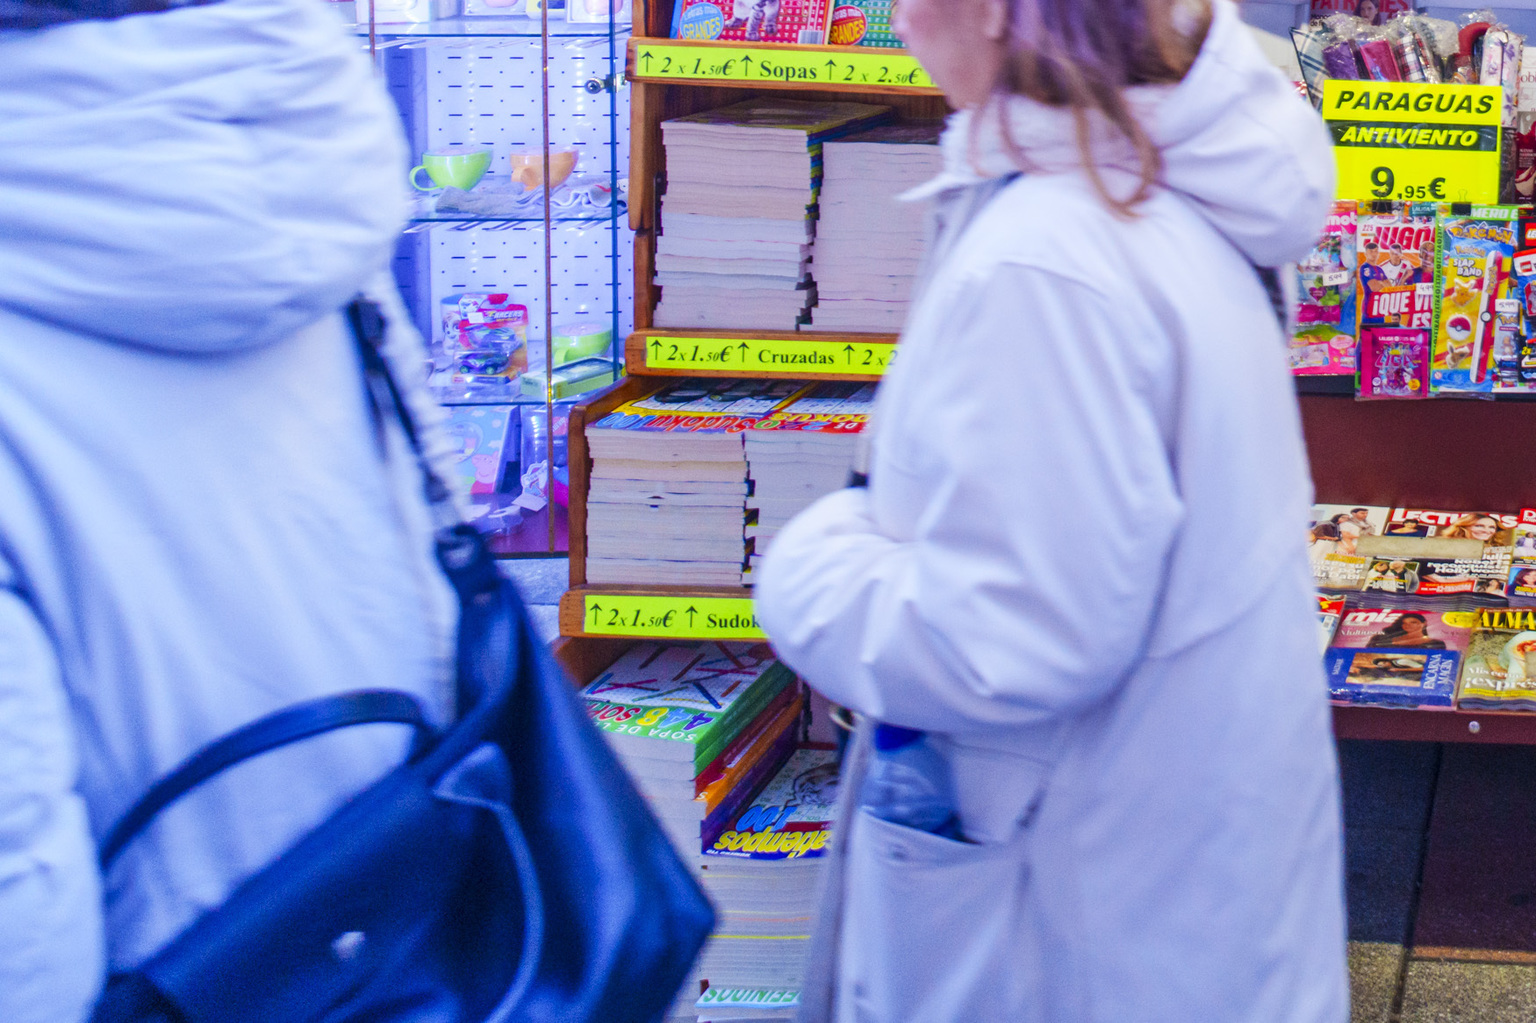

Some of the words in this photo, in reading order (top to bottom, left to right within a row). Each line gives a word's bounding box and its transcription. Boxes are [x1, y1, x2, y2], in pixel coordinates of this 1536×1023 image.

[683, 17, 722, 39] GRANDES
[661, 56, 671, 72] 2
[677, 63, 685, 74] x
[692, 56, 736, 76] 1.50€
[760, 59, 818, 82] Sopas
[843, 64, 855, 79] 2
[859, 71, 869, 82] x
[876, 66, 921, 84] 2.50€
[1335, 90, 1494, 114] PARAGUAS
[1340, 125, 1478, 147] ANTIVIENTO
[1453, 257, 1475, 267] SLAP
[1457, 266, 1483, 277] BAND
[667, 344, 677, 361] 2
[678, 351, 686, 362] x
[689, 345, 733, 362] 1.50€
[758, 349, 835, 364] Cruzadas
[861, 350, 874, 365] 2
[876, 356, 885, 366] x
[596, 412, 653, 430] 100
[646, 414, 755, 434] Sudoku
[606, 608, 618, 626] 2
[618, 616, 626, 627] x
[631, 609, 677, 627] 1.50€
[706, 613, 761, 629] Sudok
[1343, 609, 1403, 625] mia
[1480, 611, 1536, 630] ALMA
[614, 724, 641, 734] DE
[635, 707, 715, 731] 448
[647, 728, 697, 742] SOPA
[735, 805, 798, 832] 100
